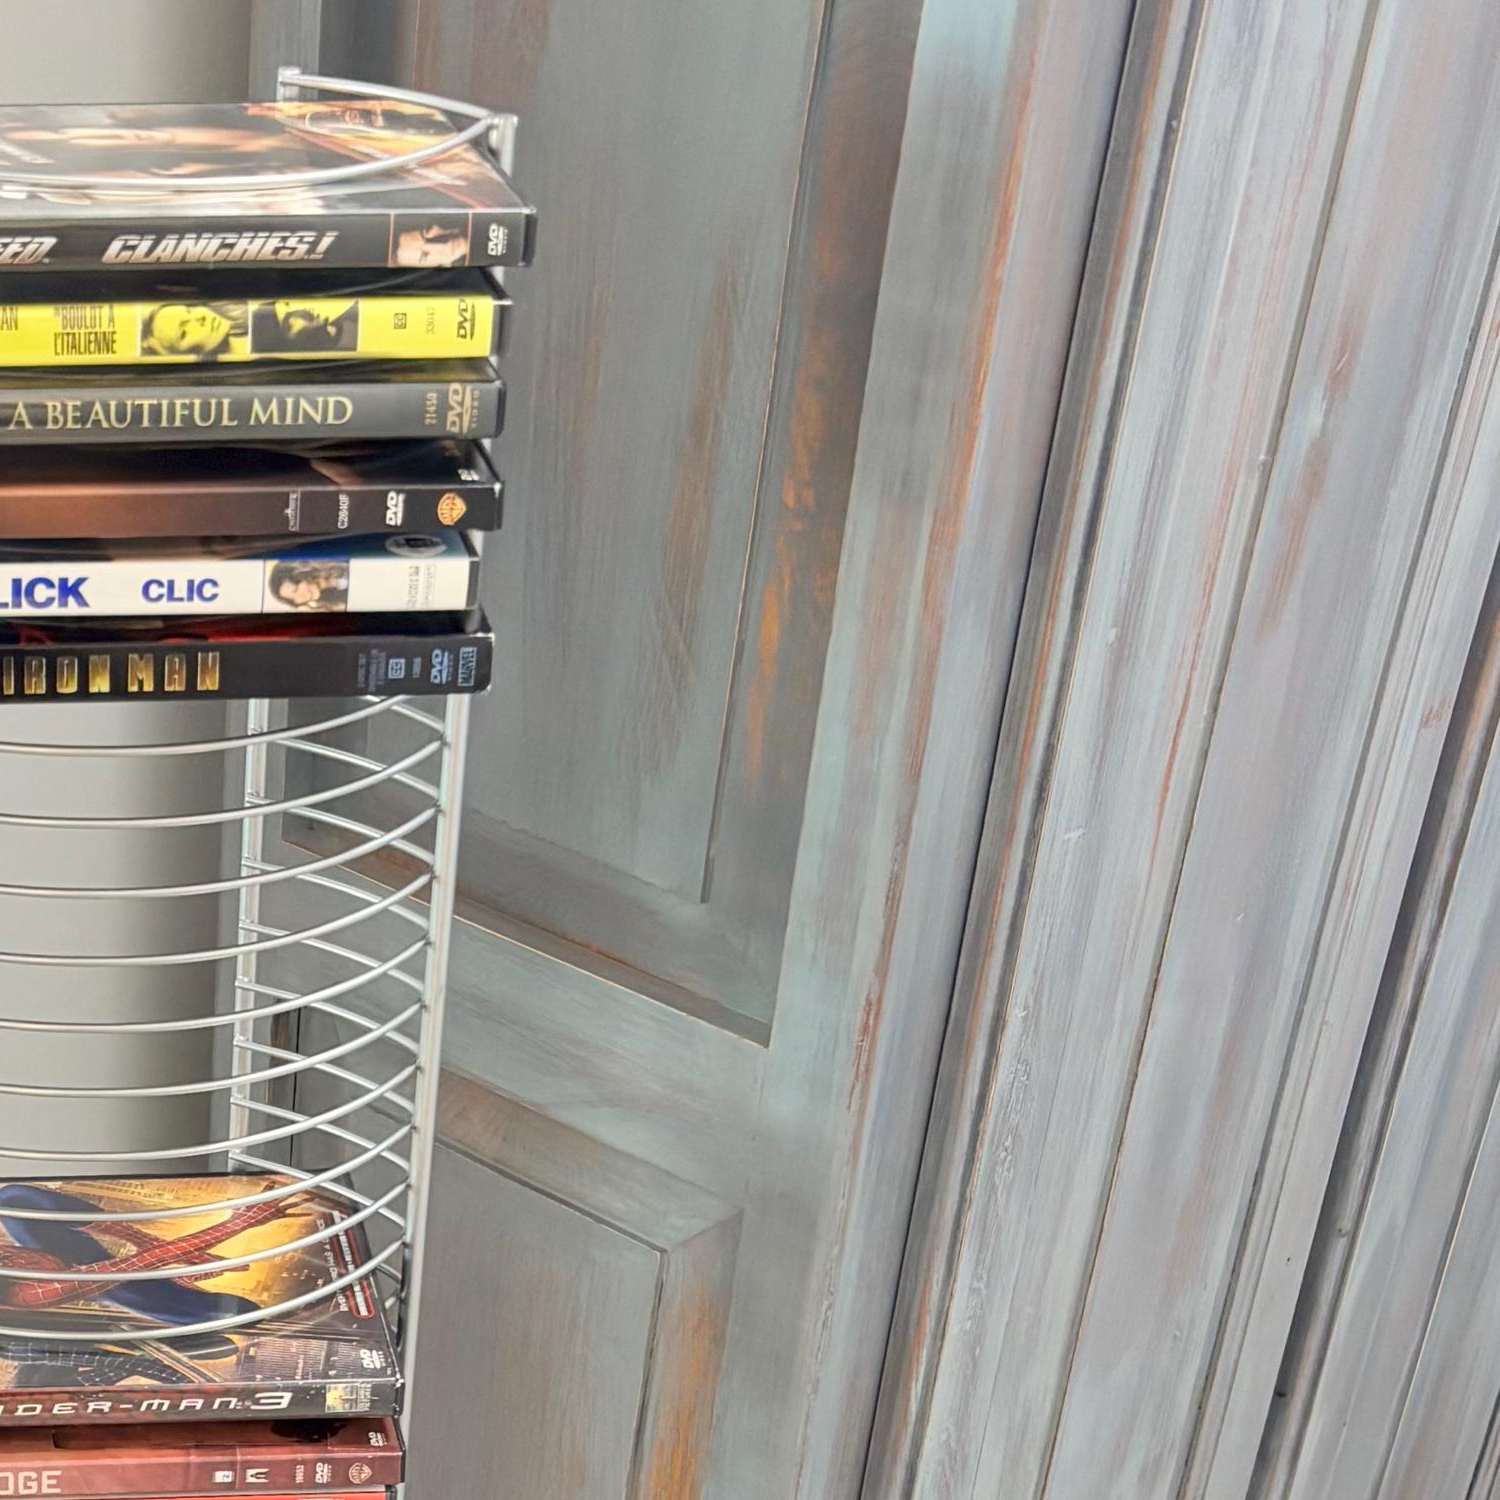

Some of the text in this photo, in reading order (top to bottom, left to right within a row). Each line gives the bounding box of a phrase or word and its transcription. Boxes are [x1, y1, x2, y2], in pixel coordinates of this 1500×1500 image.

[61, 306, 102, 331] BOULOT
[456, 300, 468, 340] DVD
[53, 331, 117, 356] L'ITALIENNE
[8, 396, 354, 430] A BEAUTIFUL MIND
[446, 382, 463, 434] DVD
[386, 491, 398, 526] DVD
[141, 577, 220, 603] CLIC
[2, 651, 220, 696] IRON MAN
[430, 649, 444, 684] DVD
[250, 1391, 293, 1410] 3
[315, 1462, 324, 1484] DVD
